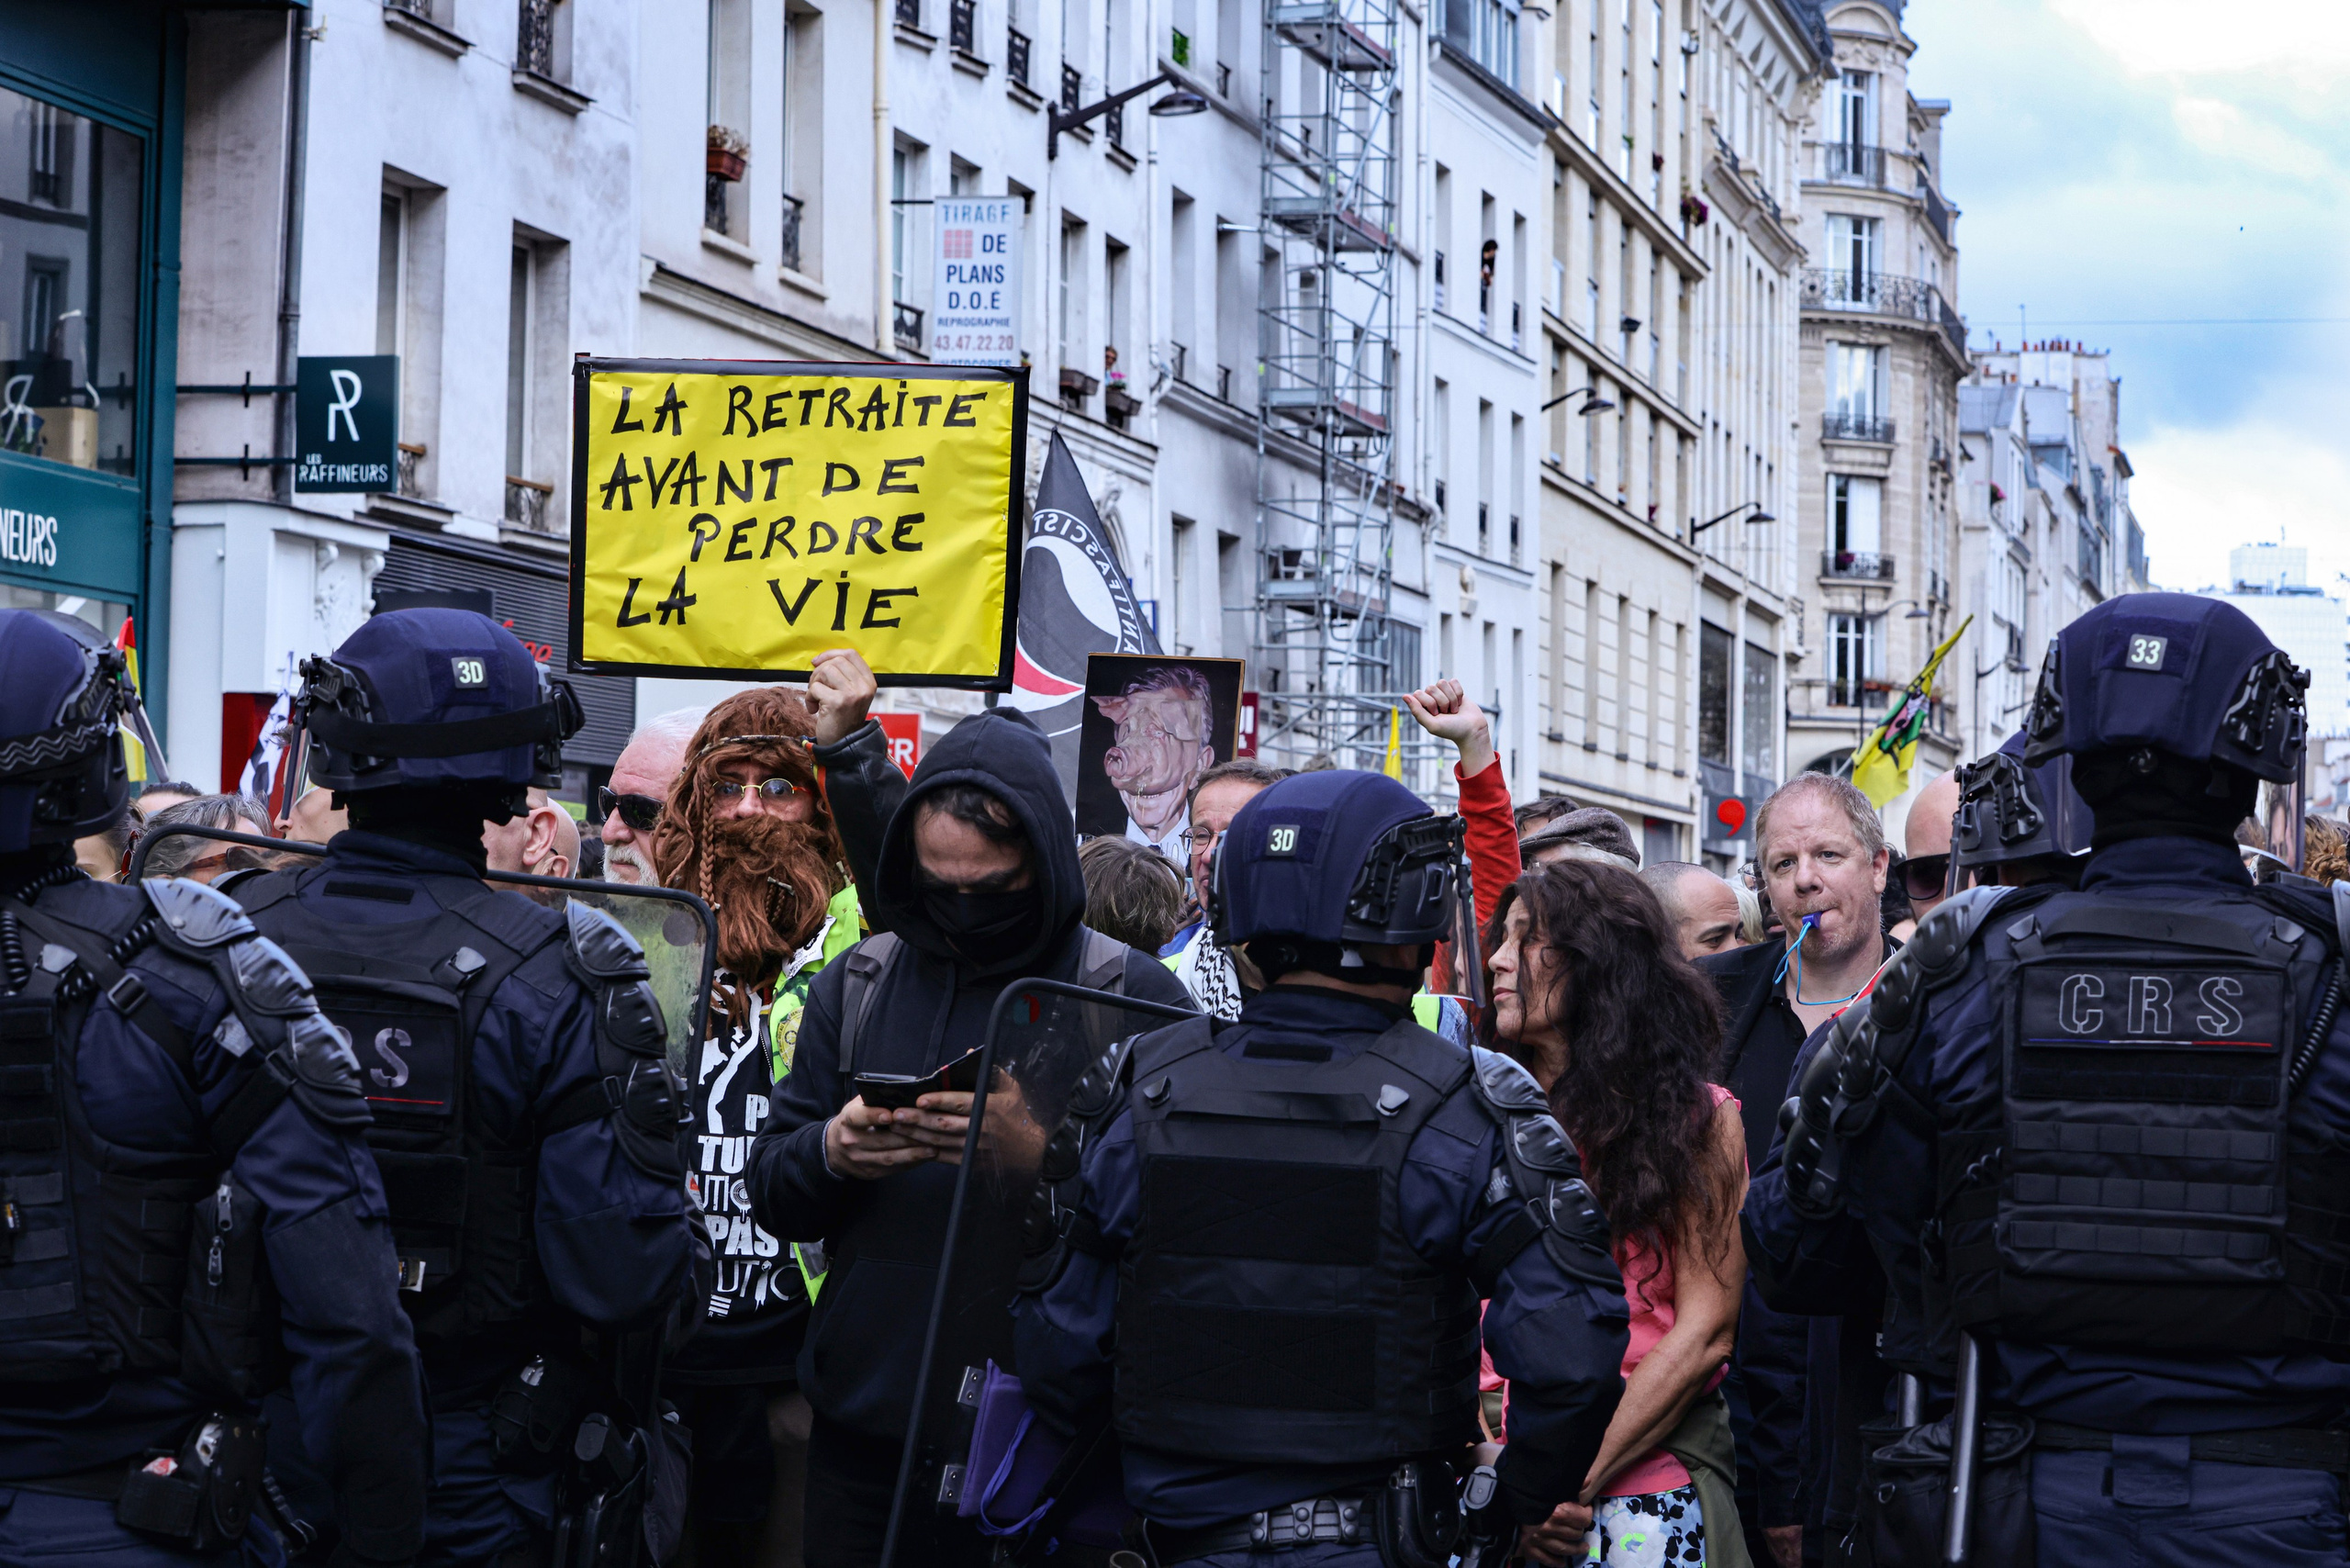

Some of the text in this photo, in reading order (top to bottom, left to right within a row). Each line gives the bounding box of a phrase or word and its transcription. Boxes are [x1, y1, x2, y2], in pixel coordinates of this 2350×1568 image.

[982, 234, 1006, 253] DE
[946, 264, 1004, 285] PLANS
[937, 317, 1010, 328] REPROGRAPHIE
[934, 335, 1014, 351] 43.47.22.20
[328, 369, 363, 442] R
[610, 382, 688, 436] LA
[306, 454, 321, 465] LES
[298, 464, 388, 482] RAFFINEURS
[599, 451, 924, 510] AVANT DE
[688, 512, 925, 563] PERDRE
[616, 565, 697, 628] LA
[2131, 638, 2160, 665] 33
